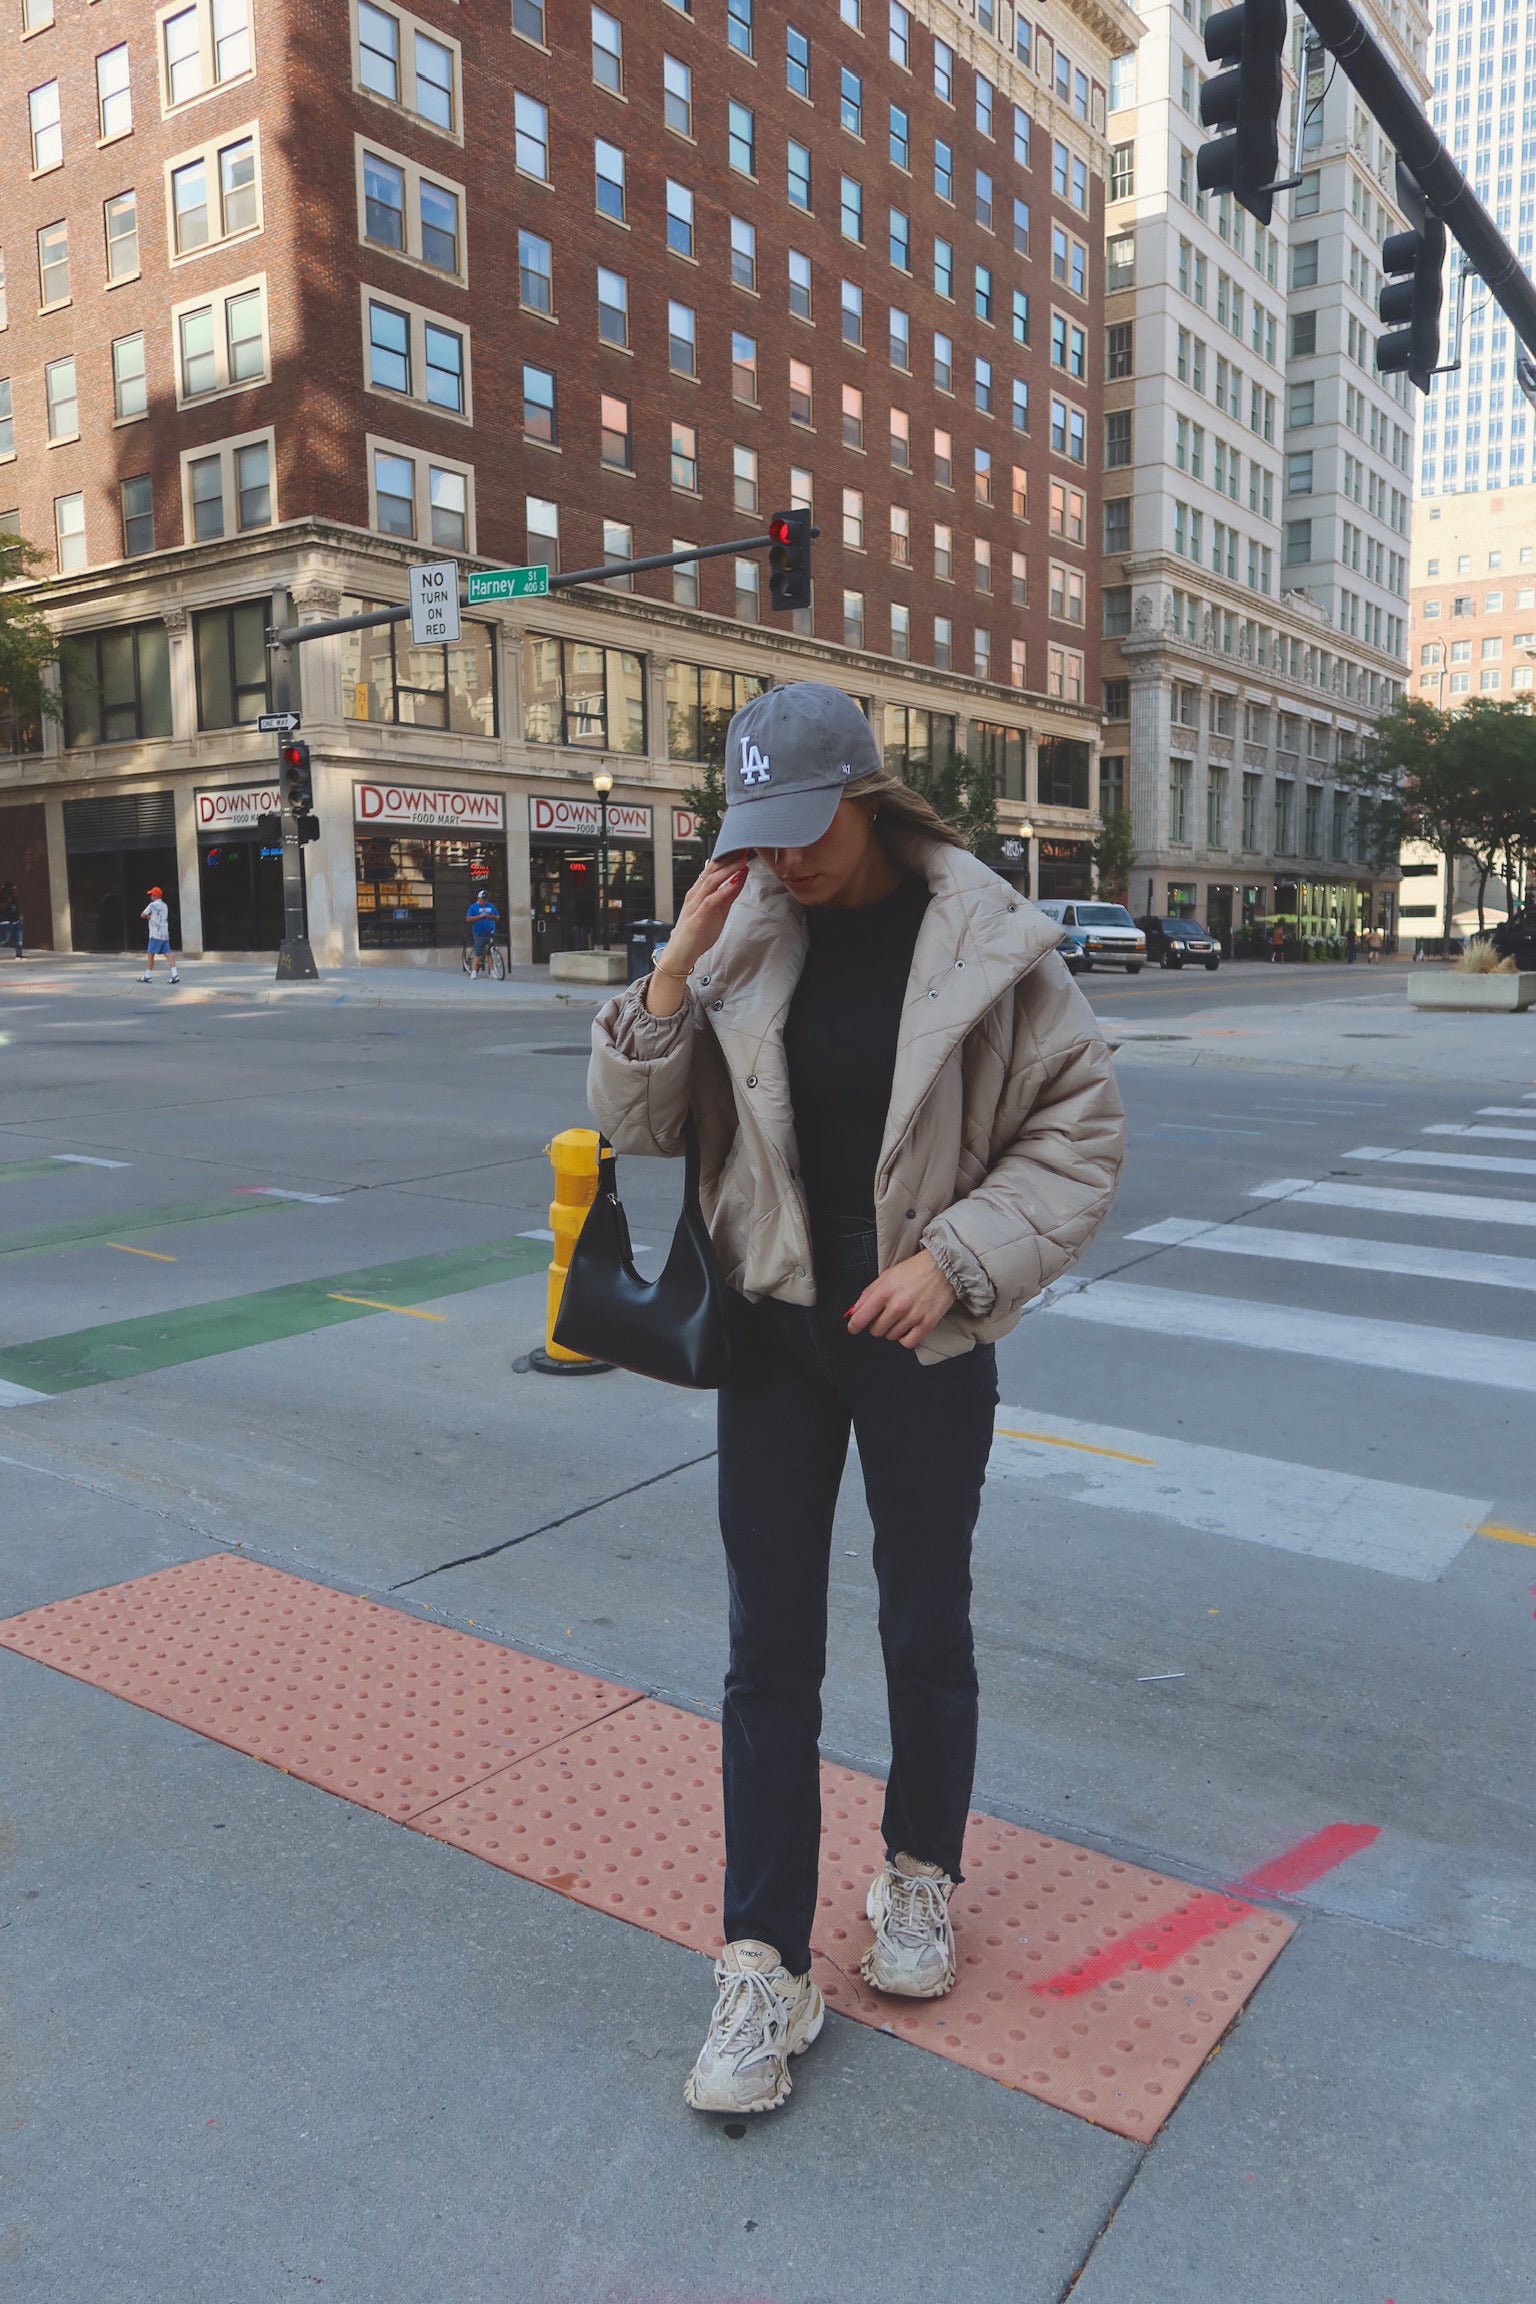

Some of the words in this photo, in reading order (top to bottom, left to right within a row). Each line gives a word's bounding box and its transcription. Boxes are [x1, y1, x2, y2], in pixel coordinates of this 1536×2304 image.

[422, 572, 444, 588] NO
[528, 571, 537, 581] St
[471, 579, 515, 597] Harney
[523, 582, 538, 593] 400
[540, 581, 545, 592] S
[421, 591, 448, 605] TURN
[428, 608, 442, 619] ON
[426, 623, 446, 636] RED
[263, 719, 274, 728] ONE
[276, 718, 289, 726] WAY
[739, 735, 771, 786] LA
[200, 791, 281, 823] DOWNTOW
[361, 786, 499, 818] DOWNTOWN
[233, 814, 249, 824] FOOD
[412, 813, 435, 824] FOOD
[437, 814, 460, 825] MART
[576, 824, 595, 833] FOOD
[570, 863, 587, 871] OPEN
